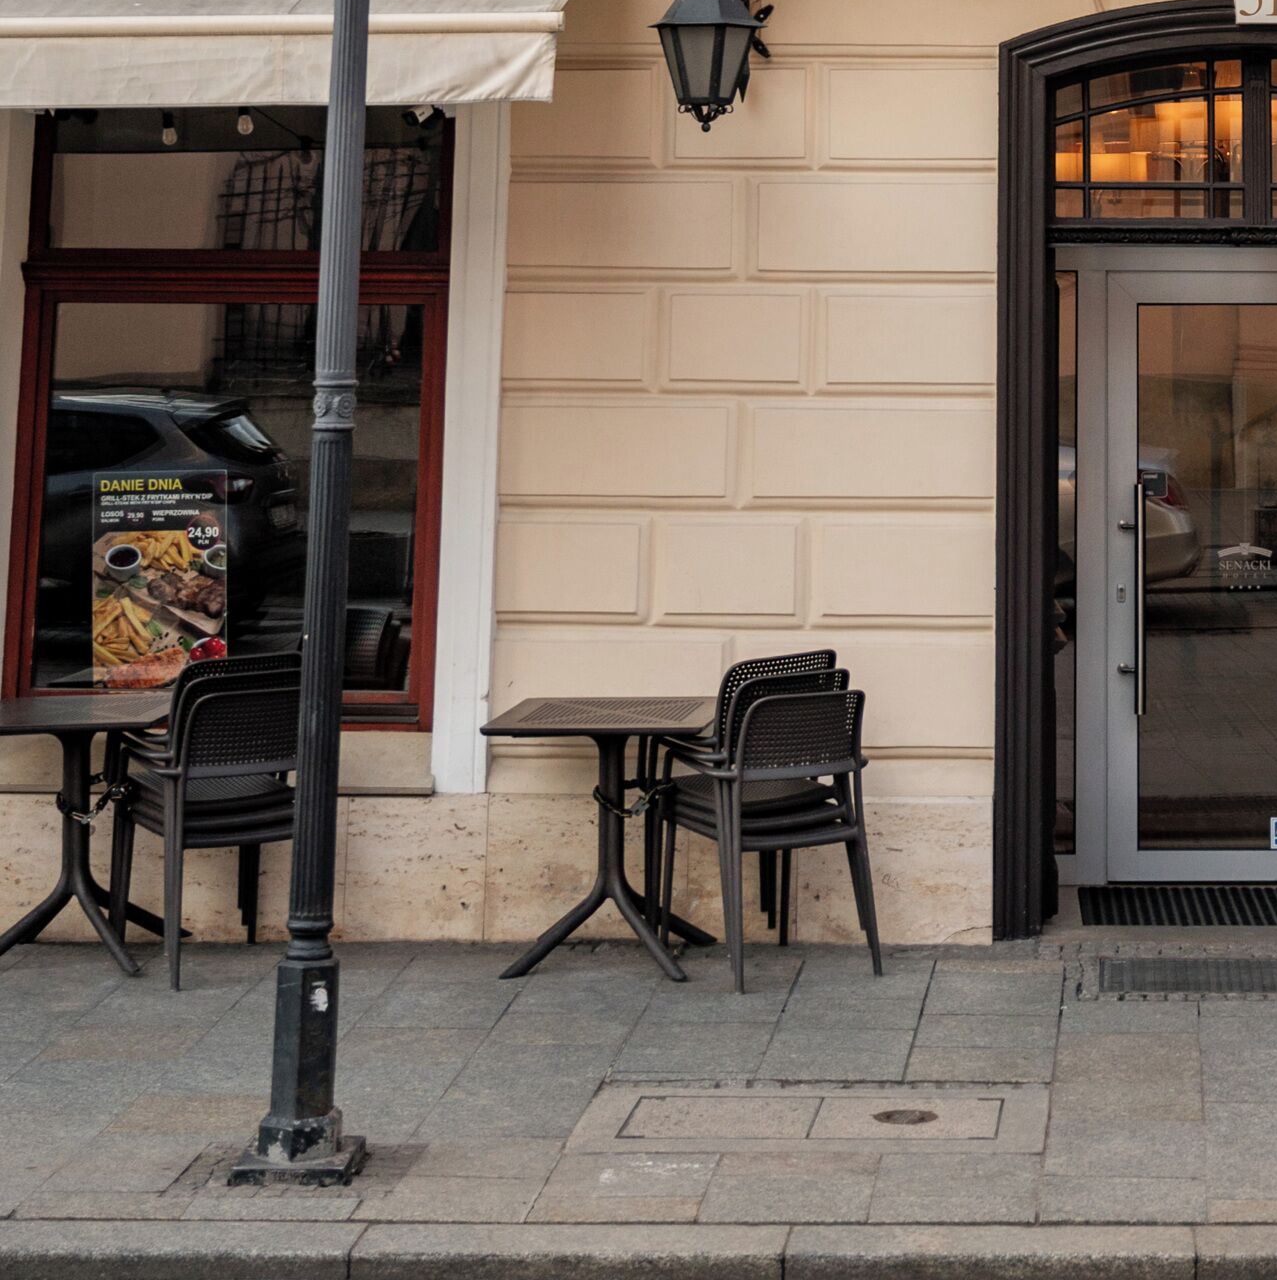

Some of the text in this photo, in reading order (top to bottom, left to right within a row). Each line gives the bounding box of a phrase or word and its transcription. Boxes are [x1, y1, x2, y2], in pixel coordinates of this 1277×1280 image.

[100, 478, 183, 492] DANIE DNIA
[188, 526, 219, 538] 24,90
[1218, 560, 1272, 570] SENACKI
